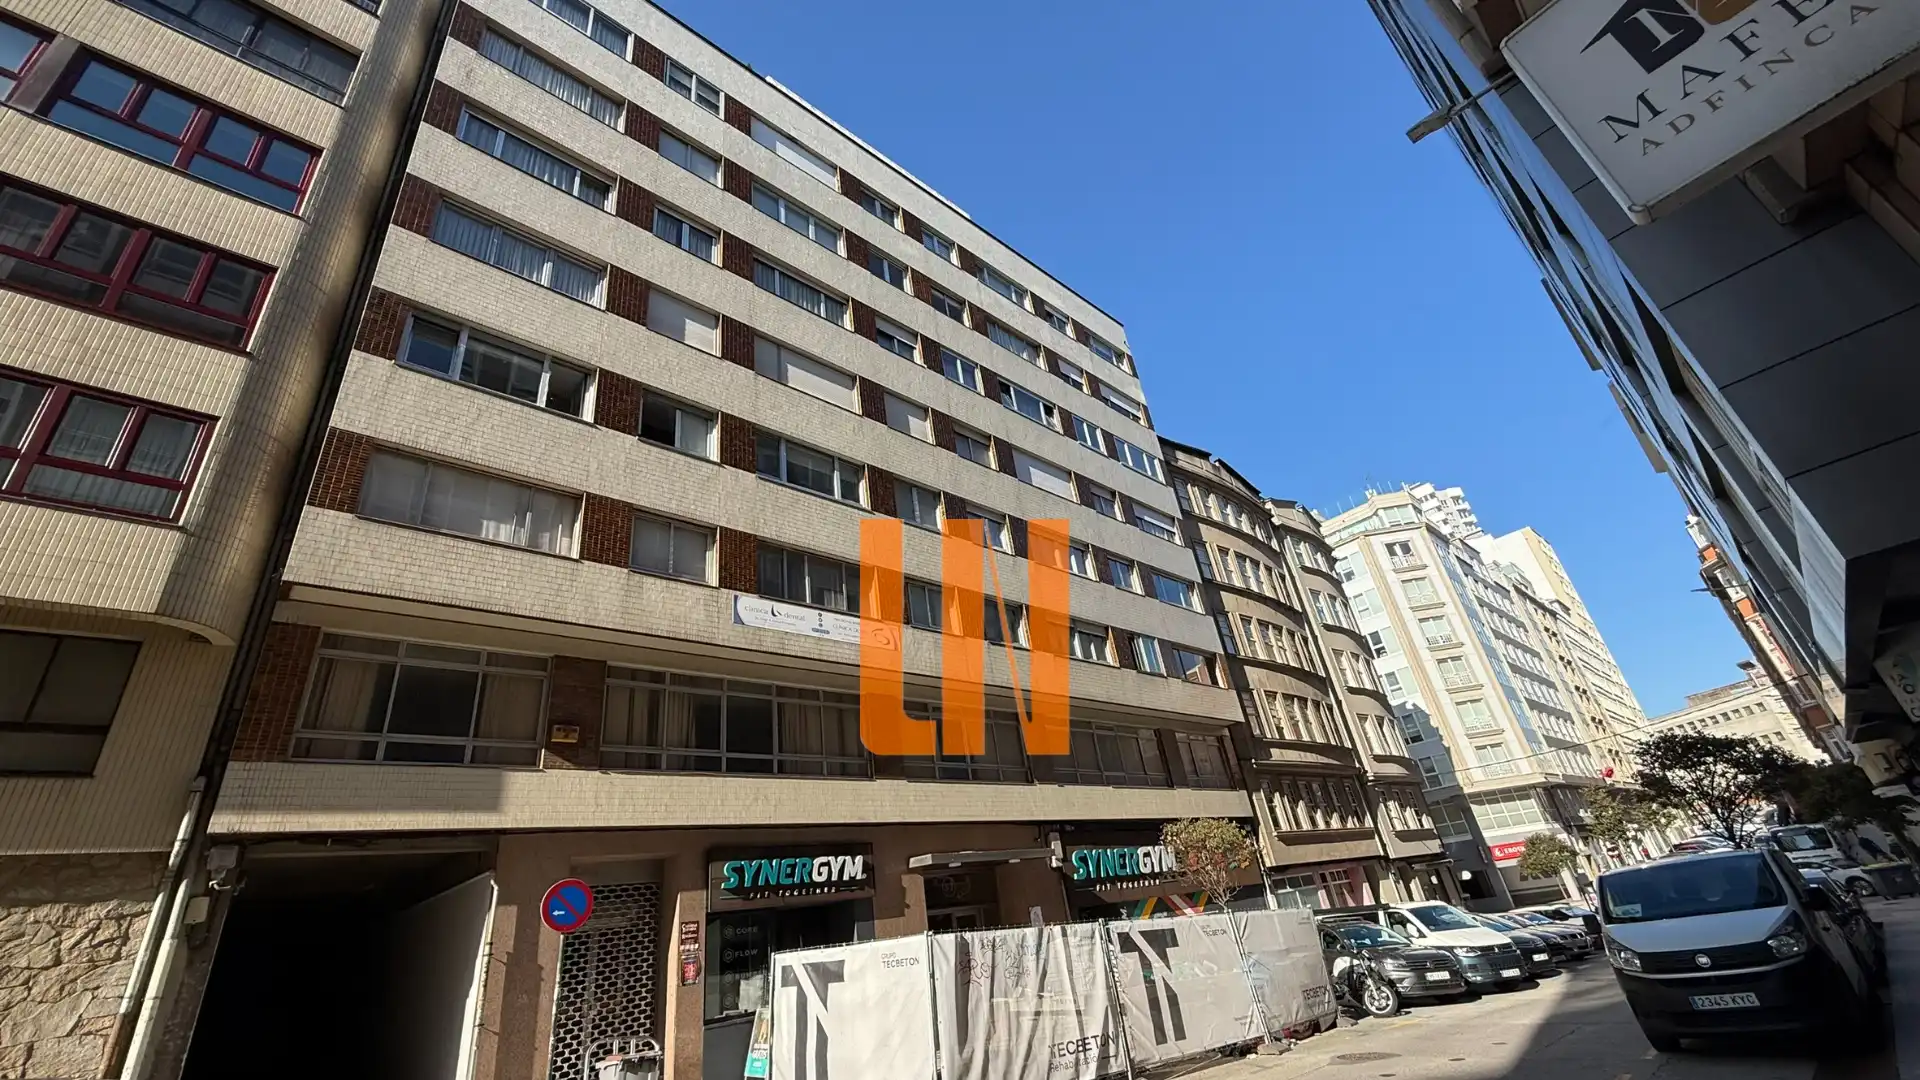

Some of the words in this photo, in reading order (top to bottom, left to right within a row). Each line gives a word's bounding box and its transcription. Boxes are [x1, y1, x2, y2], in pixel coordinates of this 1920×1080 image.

[1640, 4, 1880, 156] ADFINCA
[1503, 845, 1526, 854] EROSK
[1071, 845, 1177, 880] SYNERGYM
[1096, 882, 1111, 892] FIT
[1117, 879, 1160, 889] TOGETHER
[749, 890, 769, 899] FIT
[778, 886, 836, 897] TOGETHER
[734, 949, 758, 957] FLOW
[882, 957, 920, 969] TECBETON
[1698, 995, 1728, 1008] 2345
[1729, 994, 1756, 1006] KYC
[1048, 1031, 1116, 1059] TECBETON
